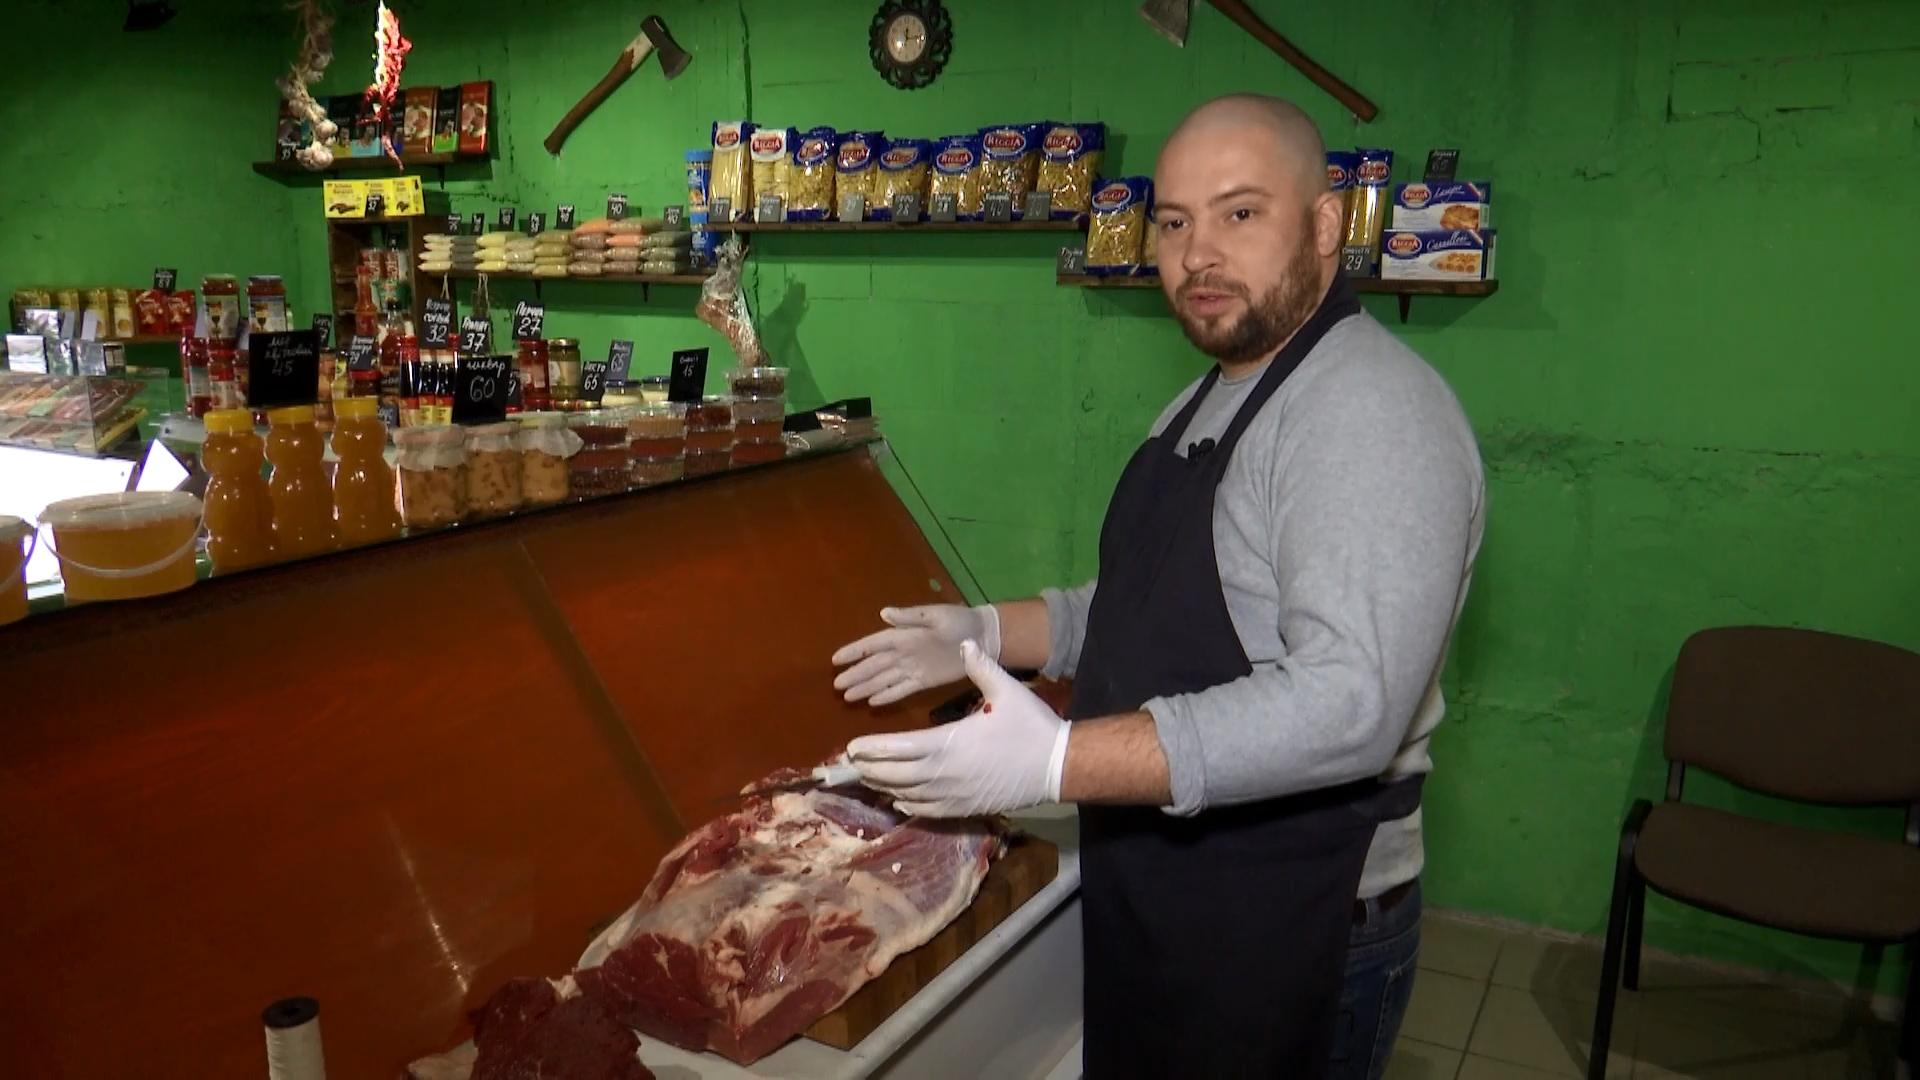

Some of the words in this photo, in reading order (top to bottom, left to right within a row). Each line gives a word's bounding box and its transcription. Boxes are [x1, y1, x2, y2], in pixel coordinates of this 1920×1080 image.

[1345, 255, 1363, 270] 29
[426, 325, 448, 342] 32
[517, 317, 541, 336] 27
[462, 333, 486, 352] 37
[469, 376, 495, 402] 60
[584, 373, 600, 391] 65
